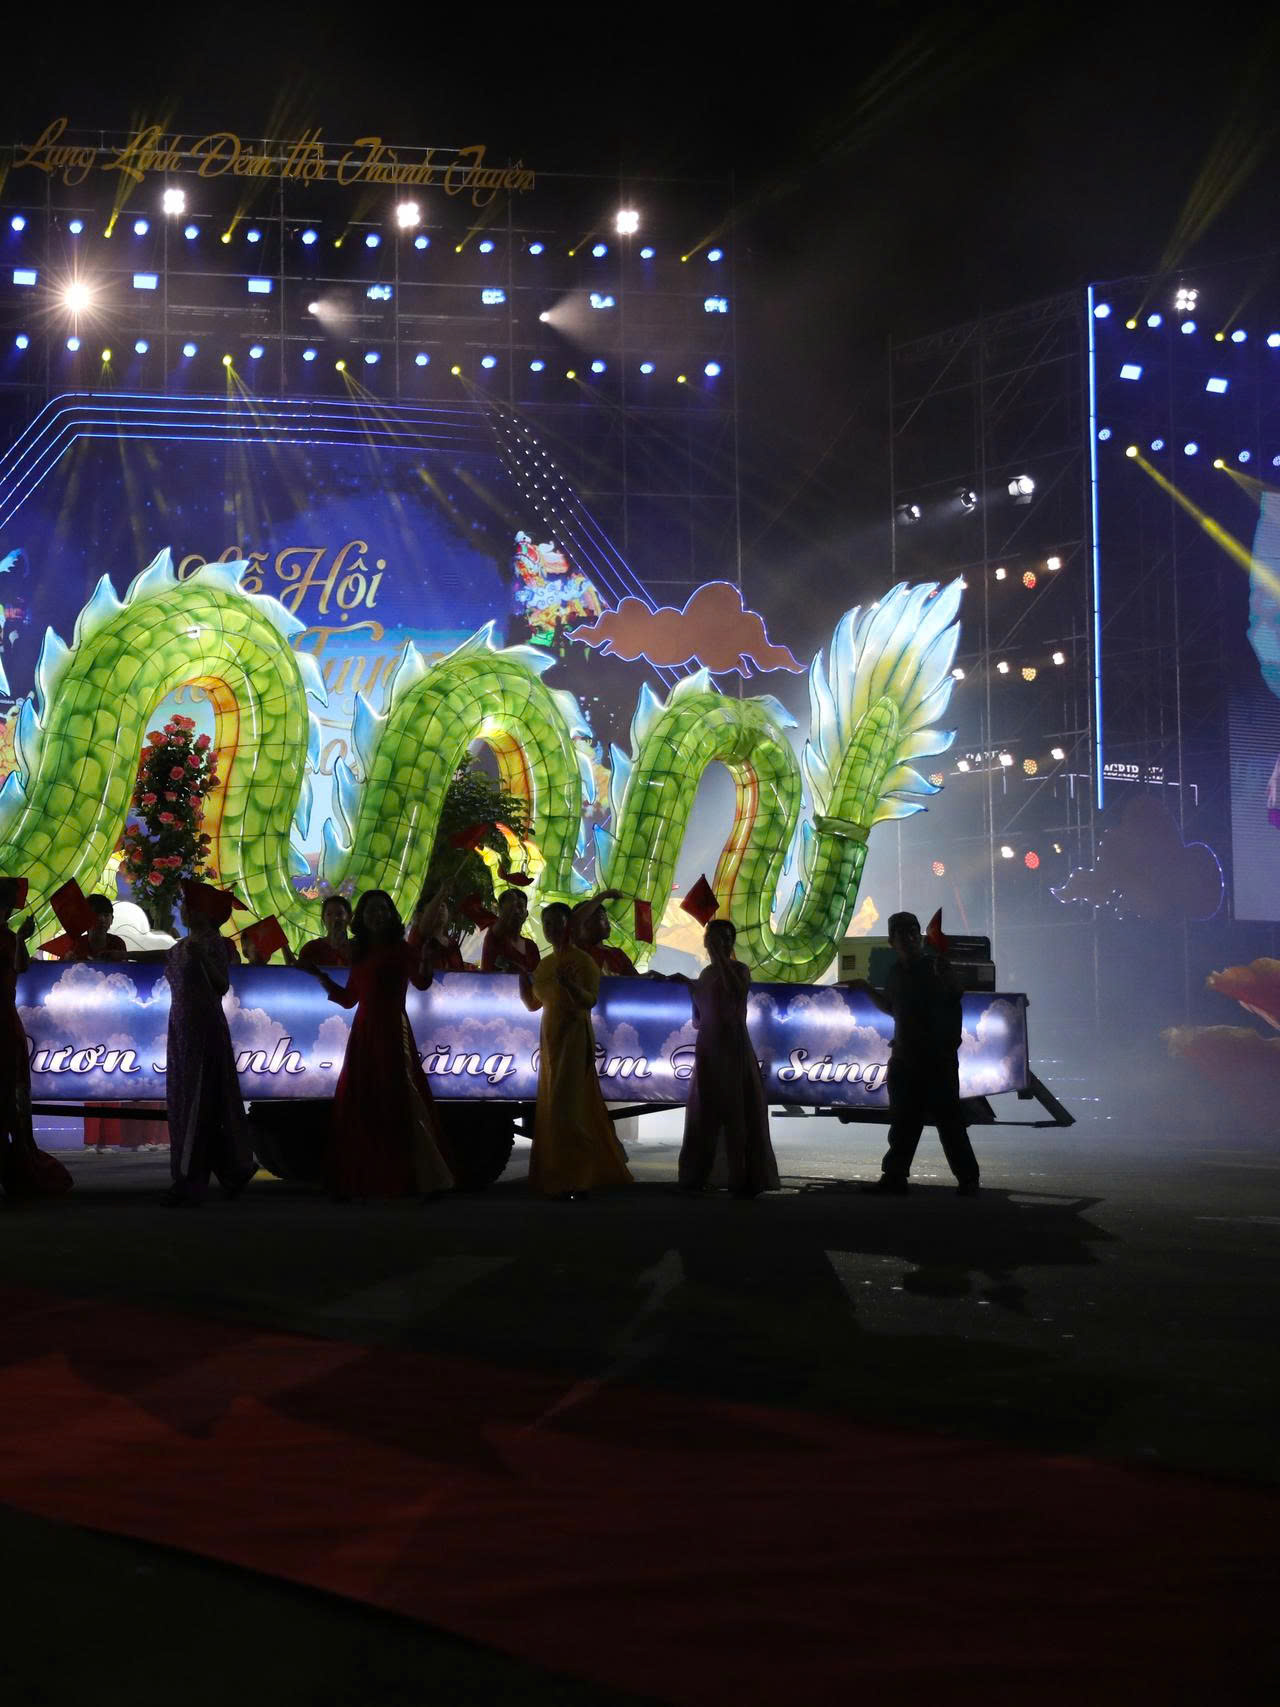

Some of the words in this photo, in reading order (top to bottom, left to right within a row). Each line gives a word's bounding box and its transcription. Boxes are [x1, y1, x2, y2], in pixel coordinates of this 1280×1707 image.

[102, 125, 182, 183] Linh
[275, 540, 386, 622] Hội
[27, 1035, 140, 1073] ươn
[417, 1044, 517, 1084] ăng
[776, 1048, 888, 1092] Sáng
